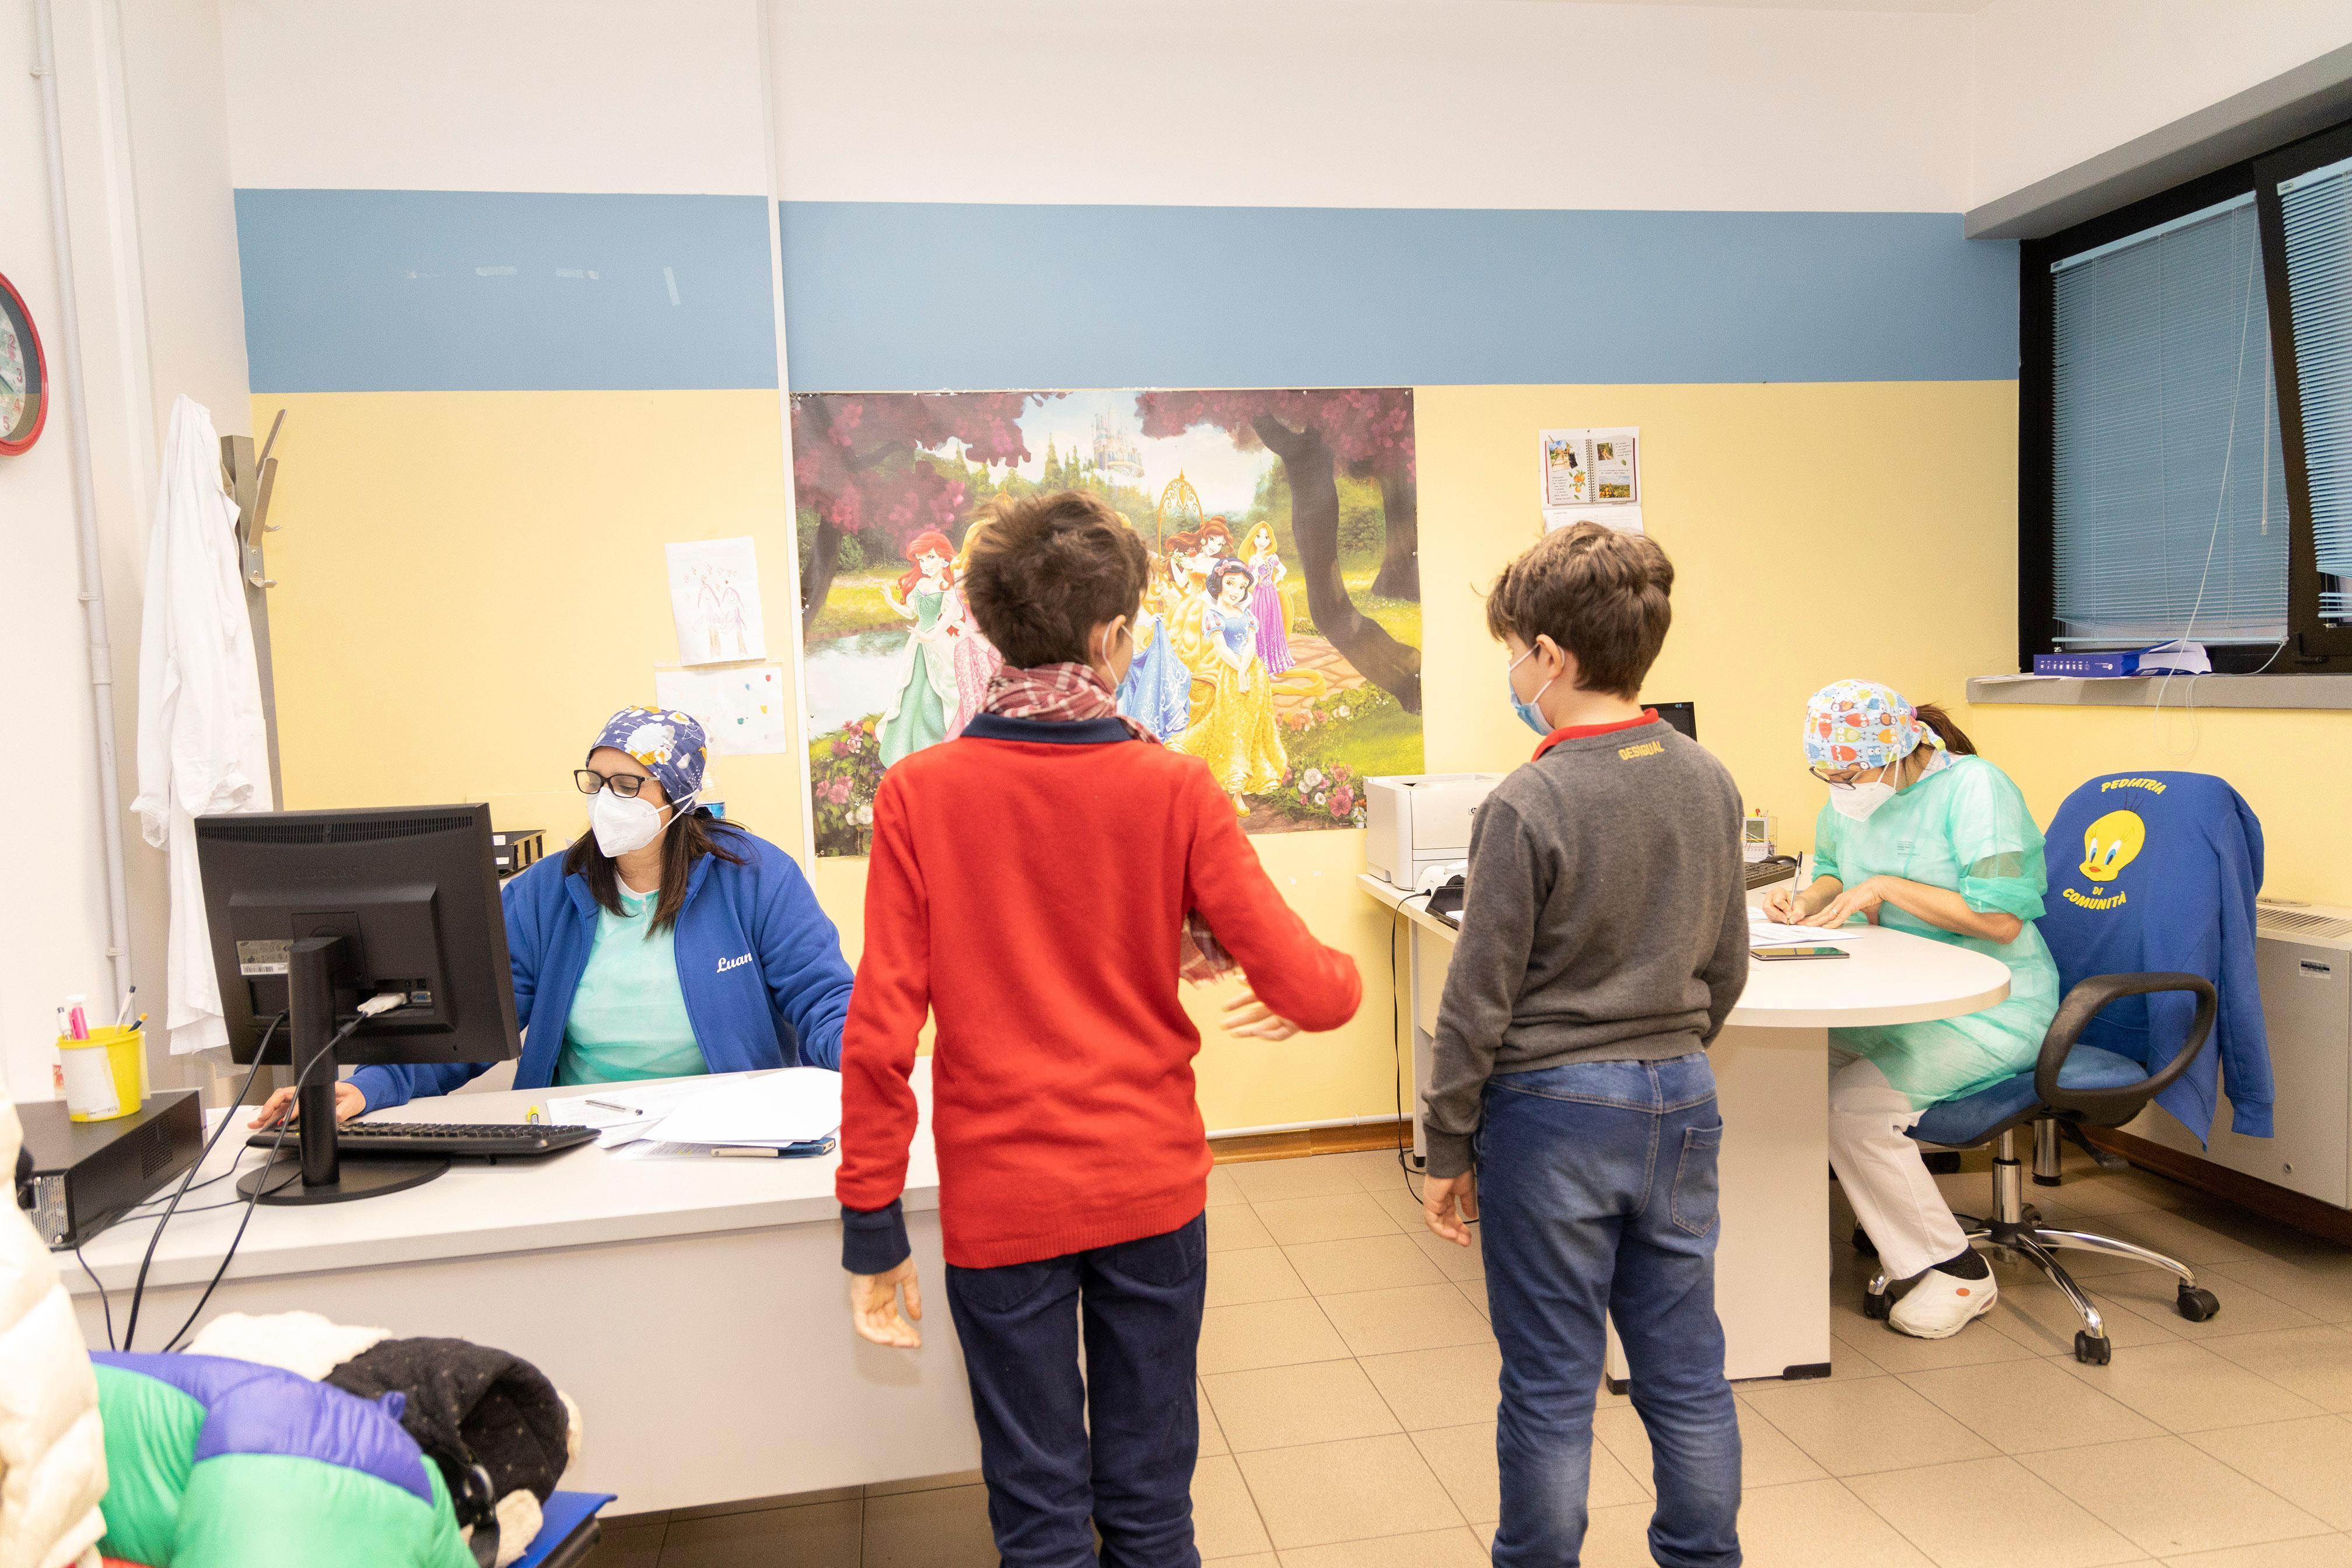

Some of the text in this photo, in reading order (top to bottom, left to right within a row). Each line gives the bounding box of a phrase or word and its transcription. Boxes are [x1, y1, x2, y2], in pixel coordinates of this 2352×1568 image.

[2101, 778, 2166, 794] PEDIATRIA
[2063, 888, 2126, 909] COMUNITÀ
[2092, 887, 2104, 895] DI
[716, 953, 752, 974] Luan
